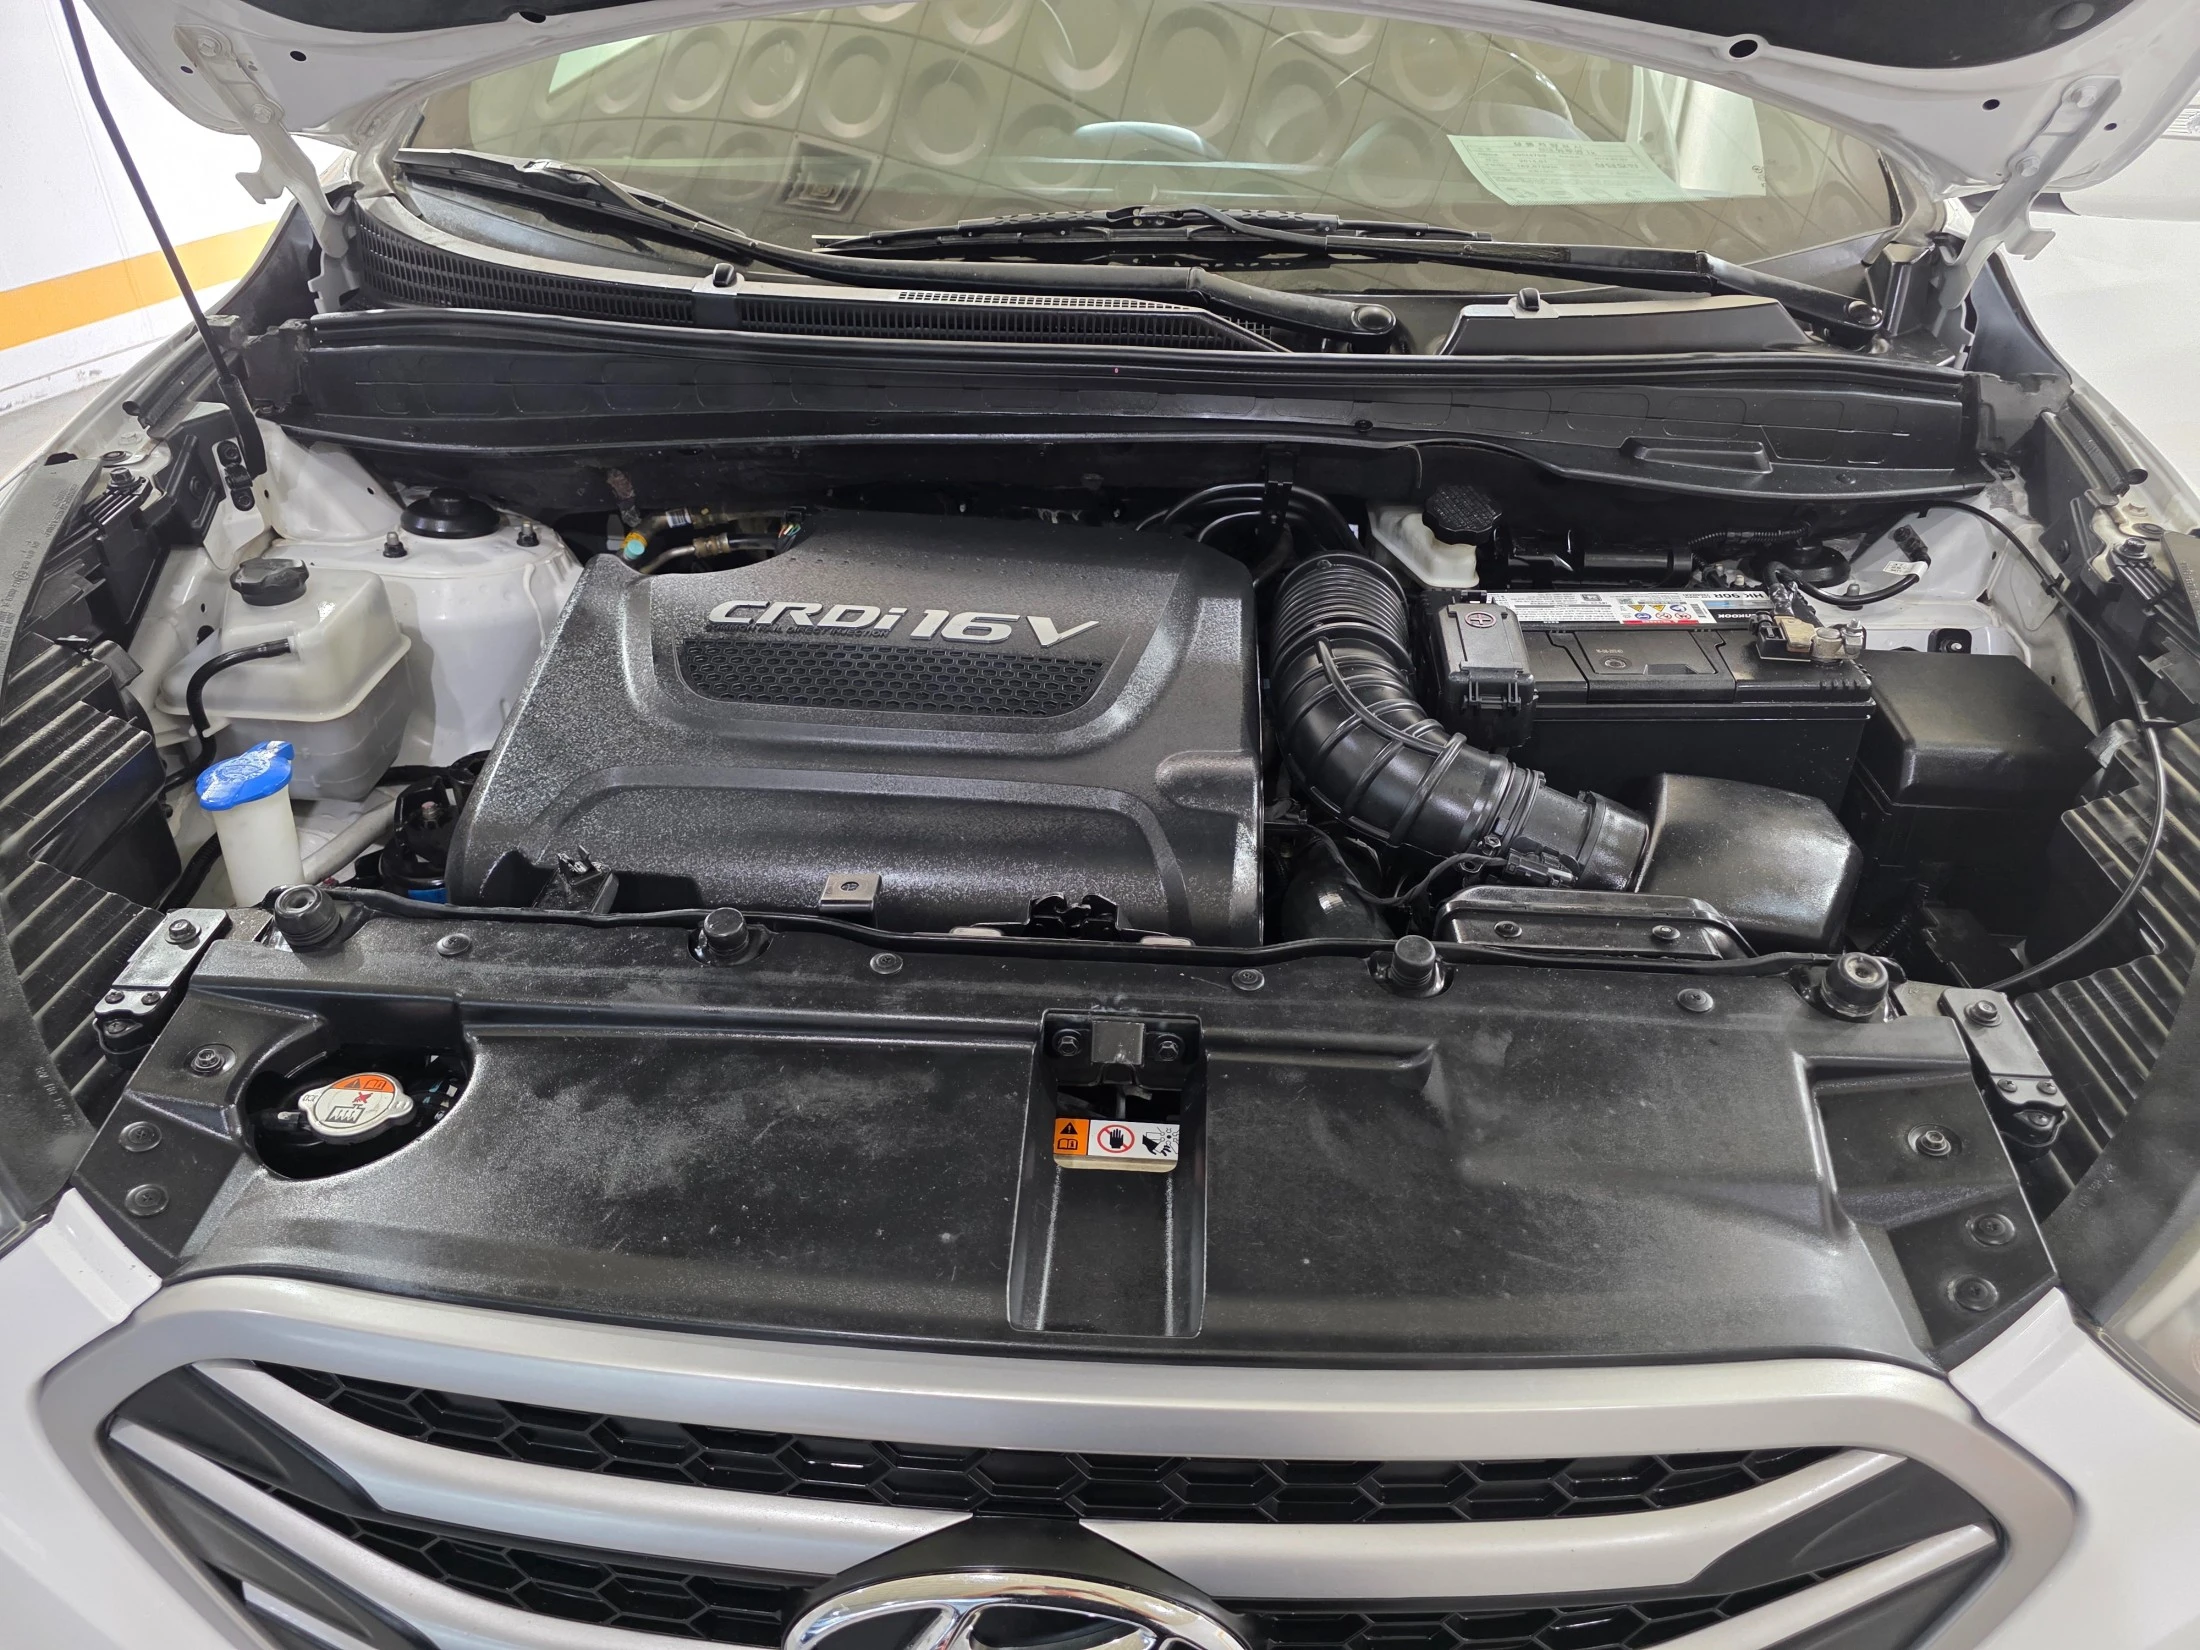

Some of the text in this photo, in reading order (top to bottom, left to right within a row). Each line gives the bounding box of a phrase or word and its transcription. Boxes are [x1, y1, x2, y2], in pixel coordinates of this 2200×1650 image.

[708, 600, 907, 630] CRDi
[786, 625, 828, 635] DIRECT
[829, 627, 890, 638] INJECTION
